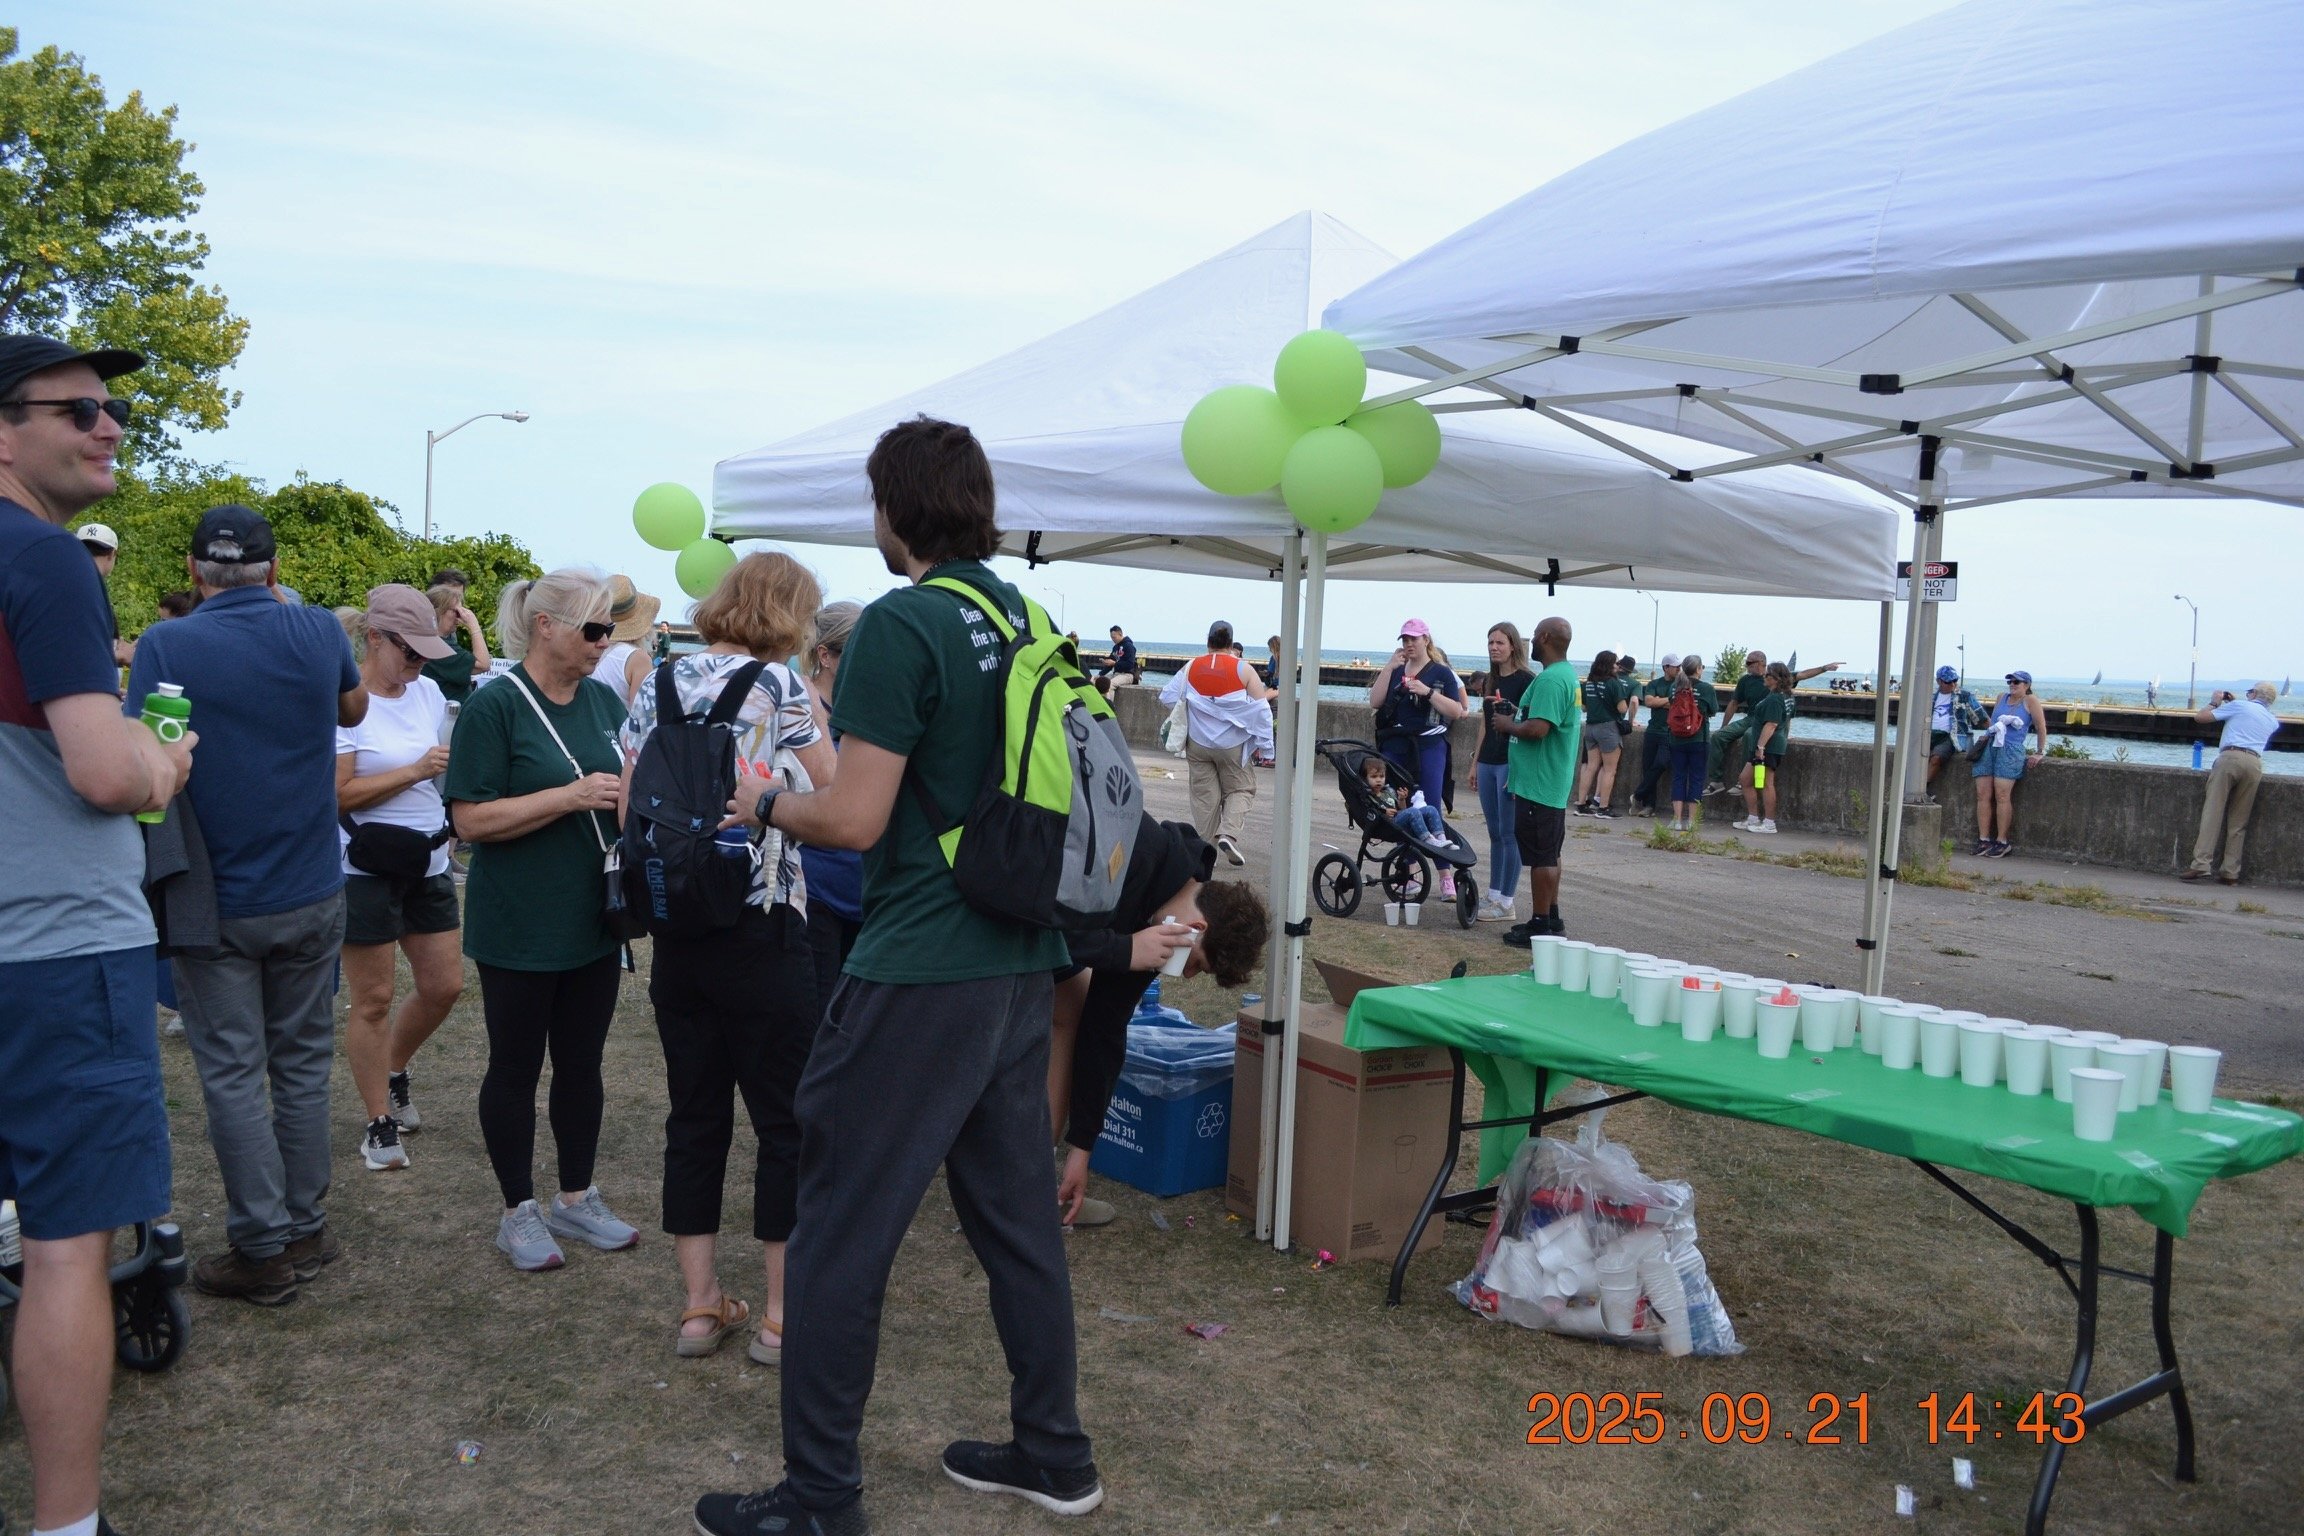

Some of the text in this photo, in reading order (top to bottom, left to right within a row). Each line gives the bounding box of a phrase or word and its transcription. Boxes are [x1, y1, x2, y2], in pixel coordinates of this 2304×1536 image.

[1923, 589, 1943, 597] TER
[1925, 580, 1947, 588] NOT
[971, 629, 989, 647] the
[979, 651, 998, 672] with
[1110, 1095, 1142, 1117] Halton
[1104, 1119, 1136, 1140] Dial 311
